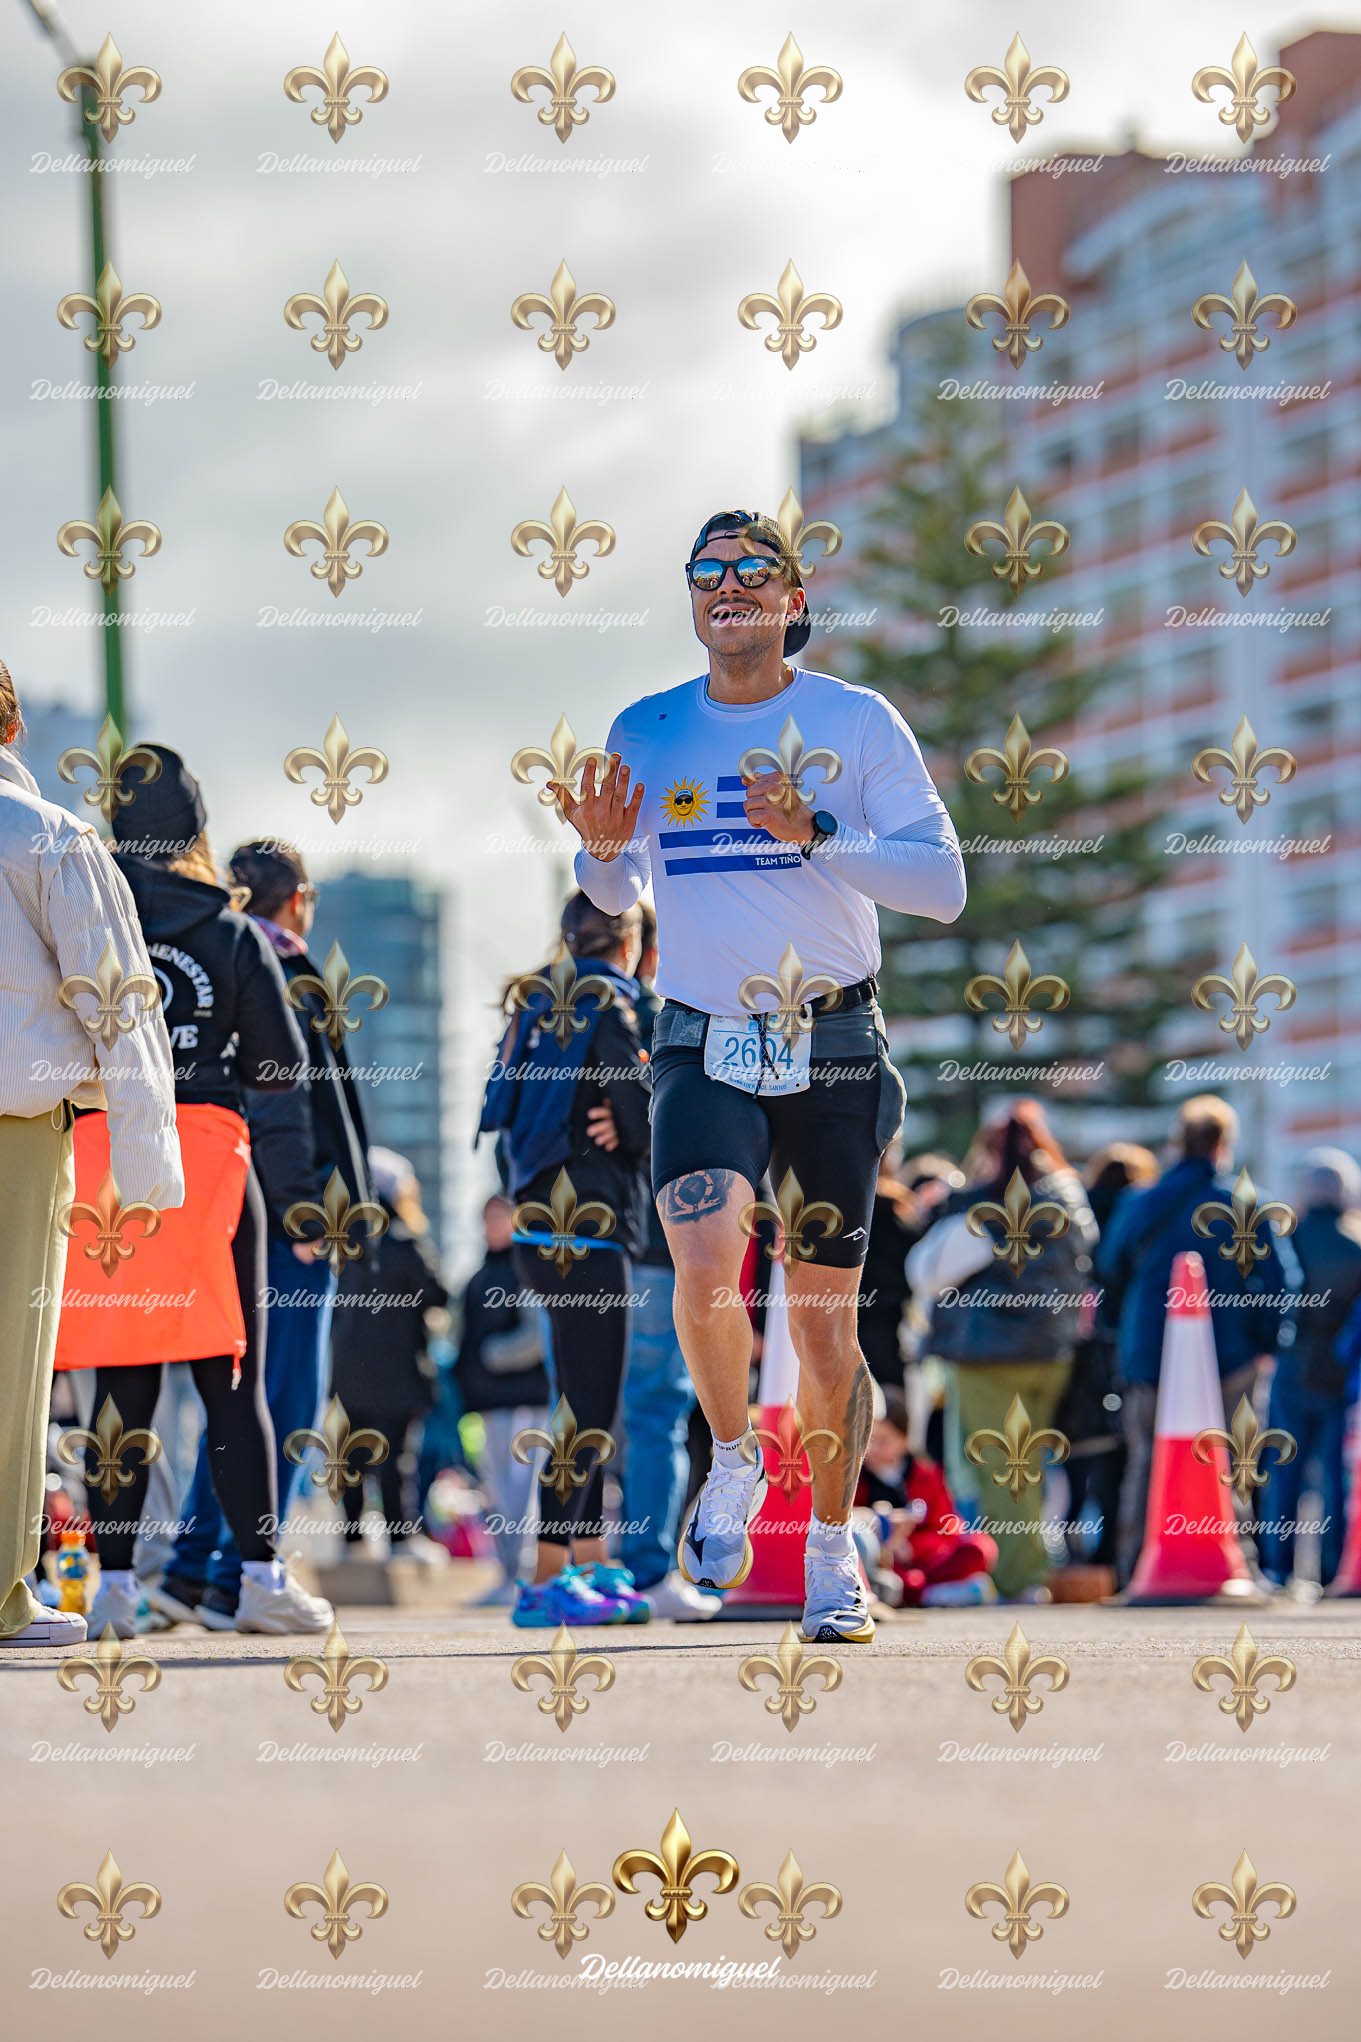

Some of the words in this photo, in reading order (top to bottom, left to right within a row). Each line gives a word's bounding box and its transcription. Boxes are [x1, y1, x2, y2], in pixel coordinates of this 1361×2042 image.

[755, 857, 778, 866] TEAM
[779, 854, 801, 865] TIÑO
[147, 942, 214, 1009] IENESTAR
[724, 1036, 794, 1069] 2604
